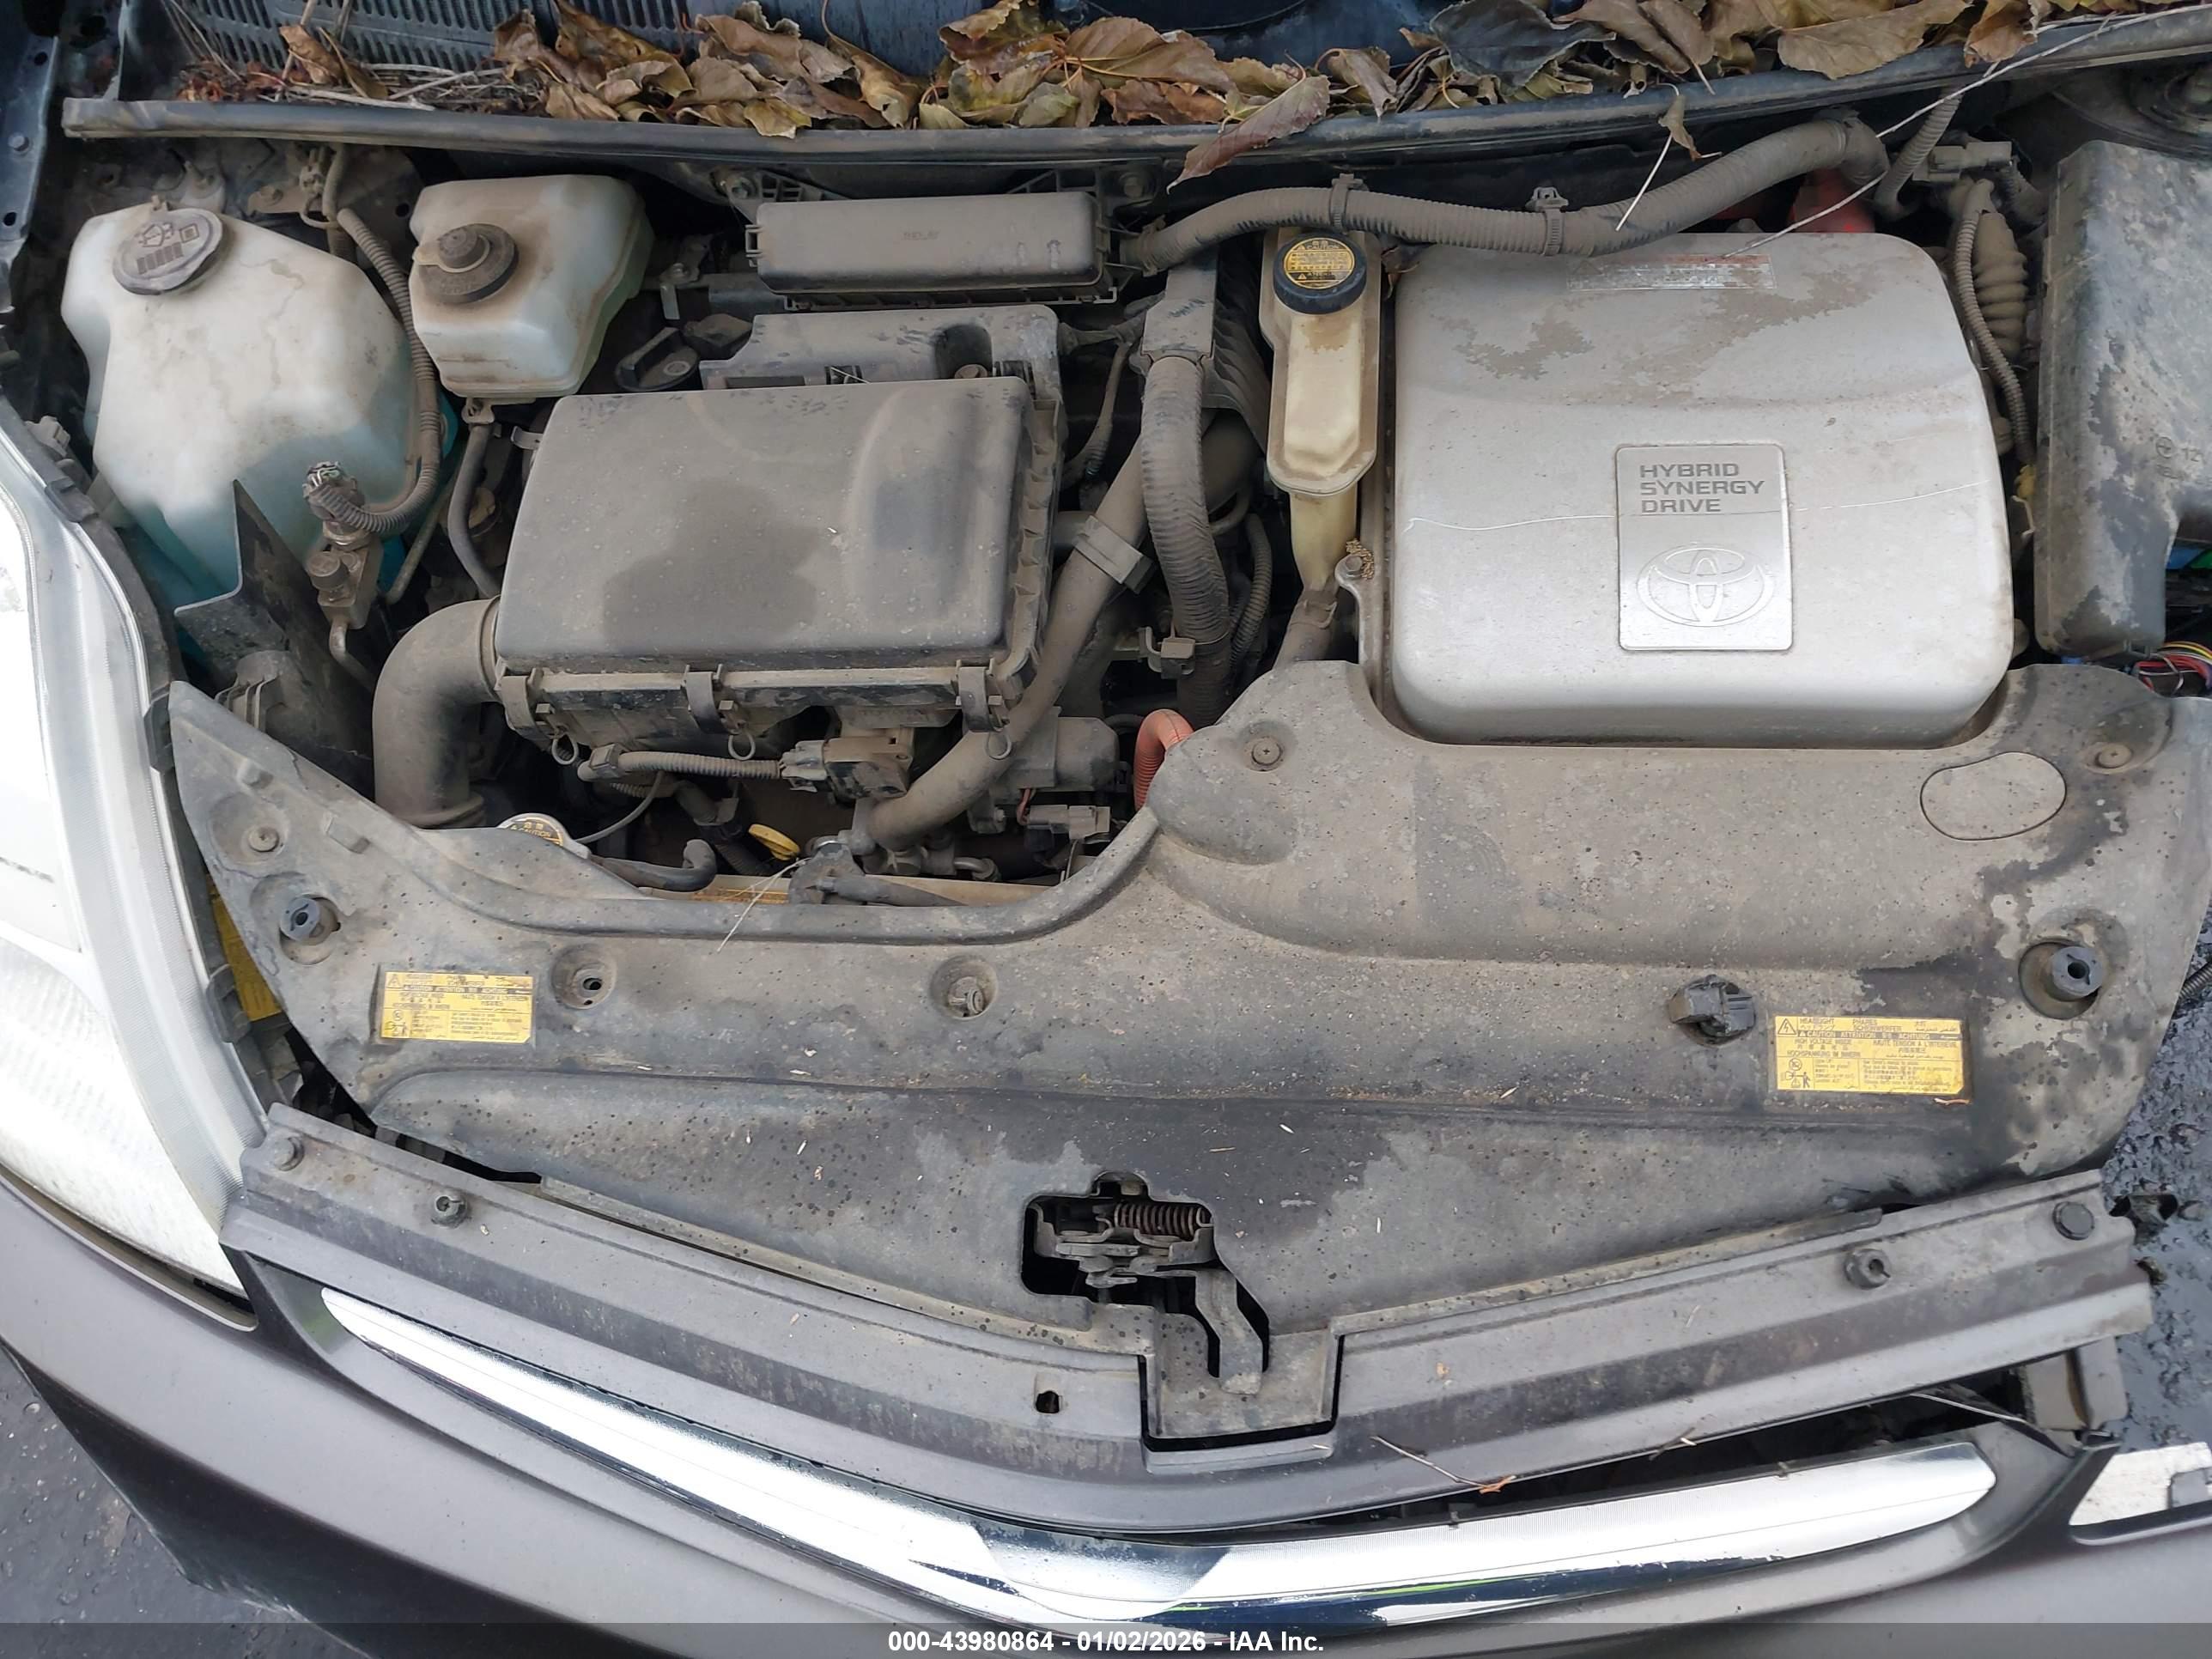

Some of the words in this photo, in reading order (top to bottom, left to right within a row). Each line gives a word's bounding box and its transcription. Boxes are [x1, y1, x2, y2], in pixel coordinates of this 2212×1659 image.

[1639, 463, 1740, 478] HYBRID
[1640, 480, 1765, 496] SYNERGY
[1641, 498, 1722, 514] DRIVE
